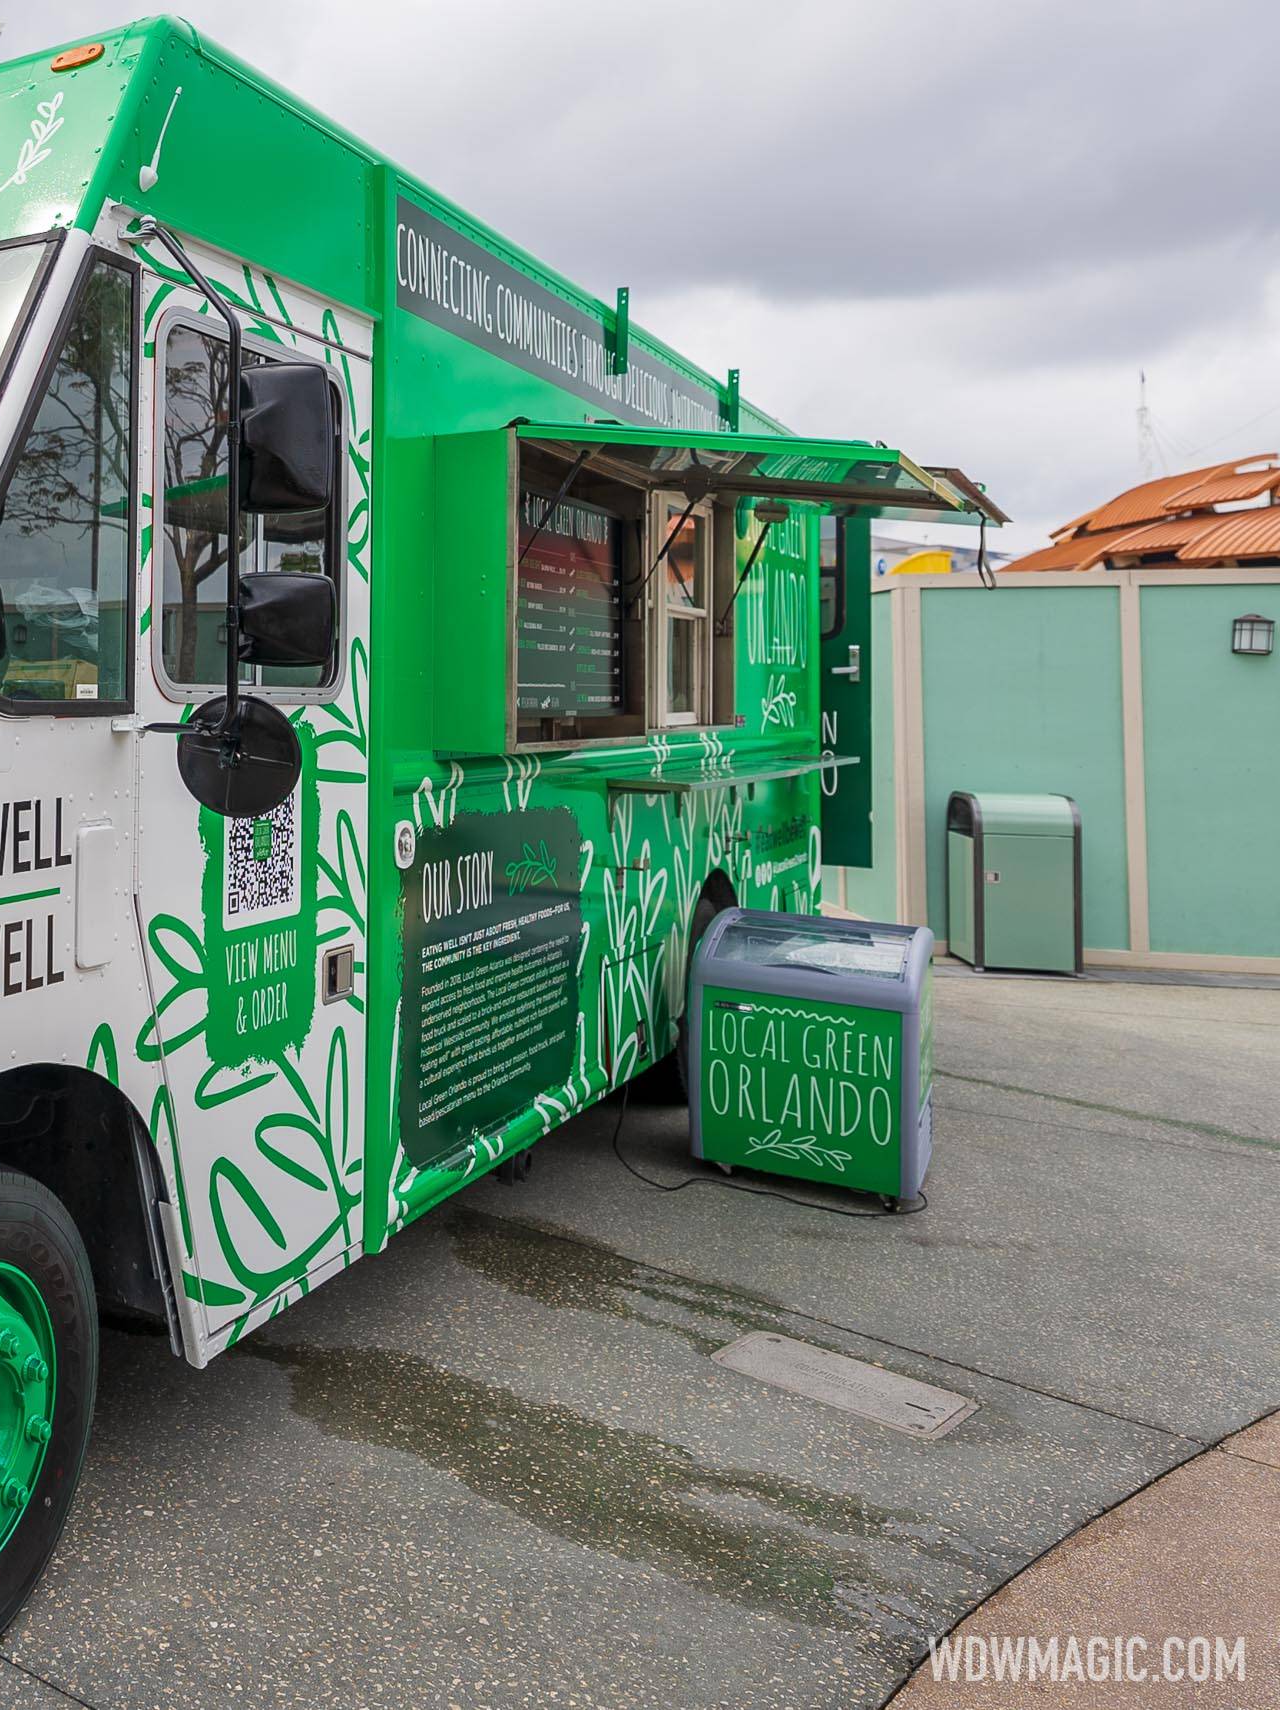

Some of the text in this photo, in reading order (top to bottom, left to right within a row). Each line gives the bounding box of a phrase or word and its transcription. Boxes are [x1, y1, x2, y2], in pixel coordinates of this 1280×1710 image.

[397, 223, 493, 334] CONNECTING
[496, 284, 578, 378] COMMUNITIES
[582, 334, 622, 402] THROUGH
[625, 361, 672, 427] DELICIOUS,
[555, 503, 574, 537] GREEN
[576, 509, 602, 545] ORLANDO
[746, 561, 807, 669] ORLANDO
[423, 850, 494, 923] OUR STORY
[225, 929, 296, 985] VIEW MENU
[421, 942, 442, 958] EATING
[442, 938, 458, 950] WELL
[458, 932, 471, 945] ISN'T
[472, 928, 484, 941] JUST
[485, 923, 501, 936] ABOUT
[502, 919, 517, 931] FRESH,
[518, 912, 537, 925] HEALTHY
[421, 960, 433, 972] THE
[433, 950, 465, 968] COMMUNITY
[493, 931, 520, 948] INGREDIENT.
[421, 980, 443, 996] Founded
[462, 968, 474, 981] Local
[475, 965, 488, 976] Green
[489, 959, 503, 970] Atlanta
[512, 948, 530, 962] designed
[421, 996, 439, 1012] expand
[440, 992, 455, 1004] access
[462, 984, 473, 995] fresh
[474, 979, 484, 990] food
[494, 970, 510, 983] improve
[511, 965, 523, 975] health
[523, 958, 542, 970] outcomes
[236, 982, 288, 1034] & ORDER
[421, 1007, 451, 1027] underserved
[452, 994, 486, 1013] neighborhoods.
[495, 984, 506, 996] Local
[507, 980, 519, 991] Green
[519, 973, 535, 986] concept
[421, 1029, 433, 1042] food
[434, 1023, 446, 1037] truck
[457, 1012, 471, 1027] scaled
[516, 986, 535, 1000] restaurant
[420, 1040, 442, 1057] historical
[443, 1030, 464, 1046] Westside
[423, 1068, 441, 1086] cultural
[442, 1058, 467, 1076] experience
[468, 1052, 477, 1064] that
[450, 1045, 460, 1057] with
[461, 1040, 473, 1055] great
[709, 1010, 892, 1080] LOCAL GREEN
[418, 1097, 462, 1127] based/pescatarian
[463, 1091, 476, 1102] menu
[491, 1074, 508, 1088] Orlando
[419, 1096, 432, 1112] Local
[433, 1090, 447, 1104] Green
[448, 1080, 466, 1096] Orlando
[472, 1069, 486, 1085] proud
[493, 1062, 504, 1074] bring
[528, 1044, 537, 1055] food
[709, 1059, 892, 1145] ORLANDO
